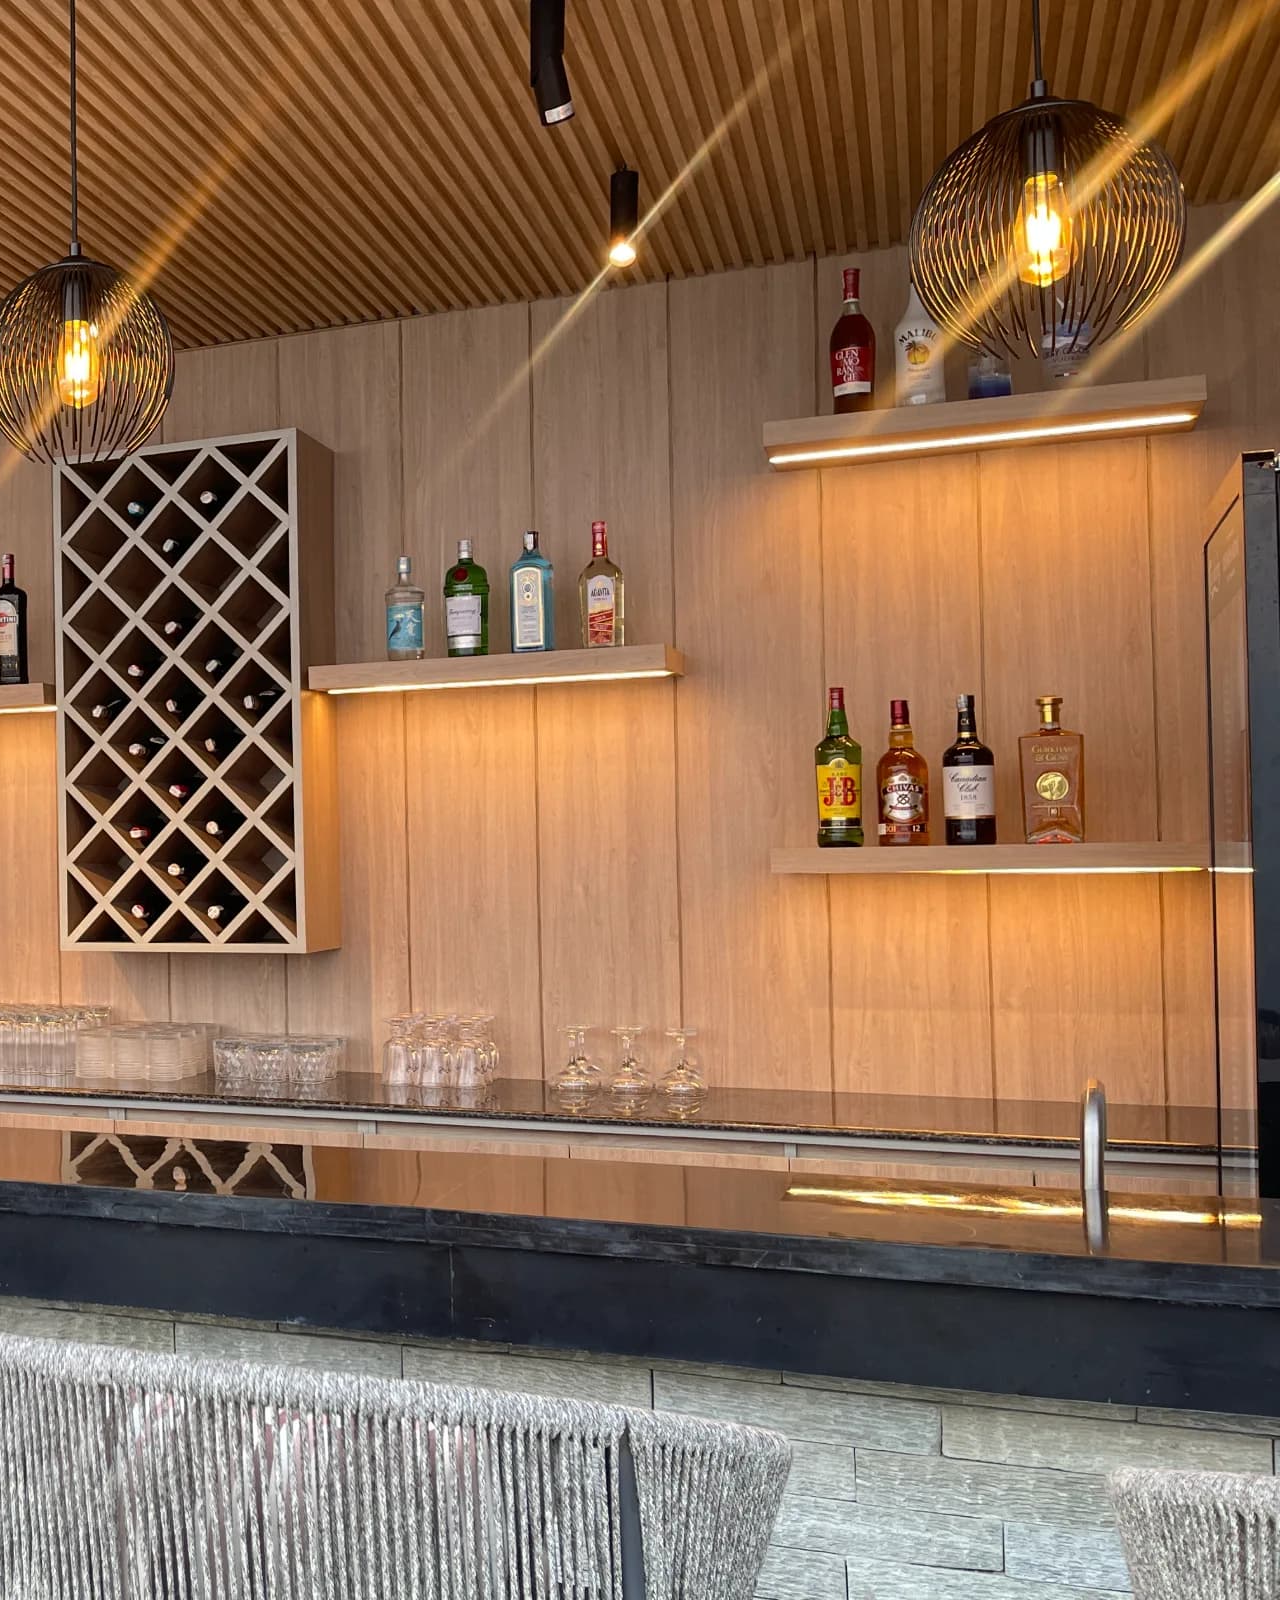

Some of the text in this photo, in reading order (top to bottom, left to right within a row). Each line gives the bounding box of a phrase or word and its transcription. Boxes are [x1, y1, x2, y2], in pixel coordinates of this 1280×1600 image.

[835, 349, 859, 361] GLEN
[842, 356, 860, 367] MO
[591, 587, 610, 598] AGAVITA
[886, 783, 920, 793] CHIVAS
